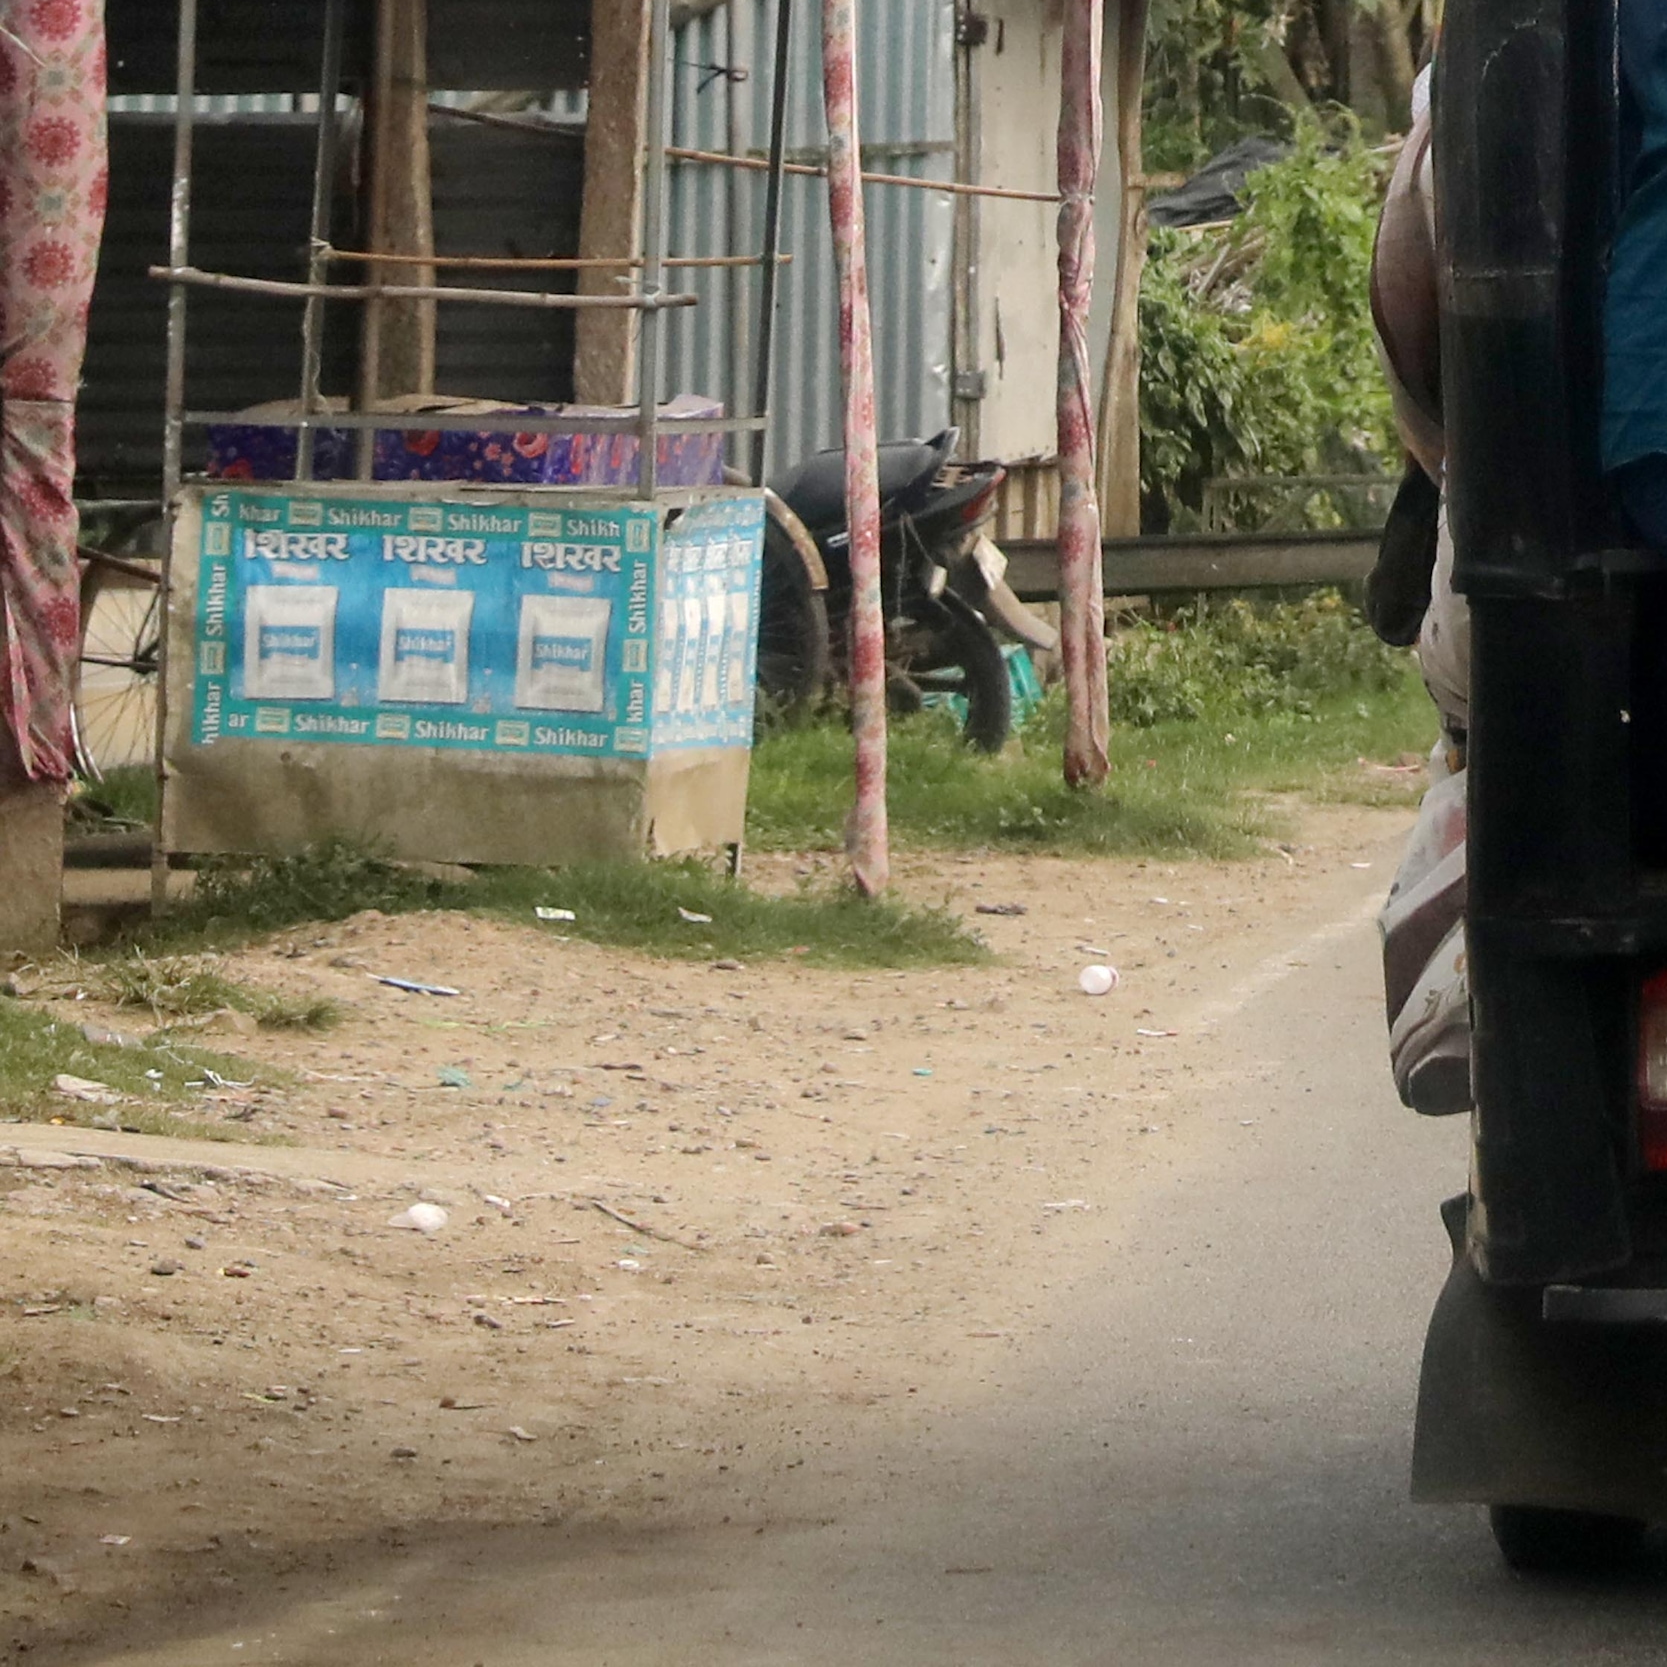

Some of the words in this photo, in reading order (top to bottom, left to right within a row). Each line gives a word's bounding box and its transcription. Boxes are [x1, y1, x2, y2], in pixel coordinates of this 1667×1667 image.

[328, 507, 402, 527] Shikhar
[448, 513, 523, 534] Shikhar
[243, 528, 350, 561] शिखर
[382, 534, 488, 565] शिखर
[520, 539, 623, 573] शिखर
[205, 563, 227, 636] Shikhar
[628, 559, 648, 634] Shikhar
[398, 634, 453, 652] Shikhar
[534, 642, 589, 661] Shikhar
[294, 713, 371, 735] Shikhar
[414, 719, 490, 742] Shikhar
[533, 725, 608, 748] Shikhar
